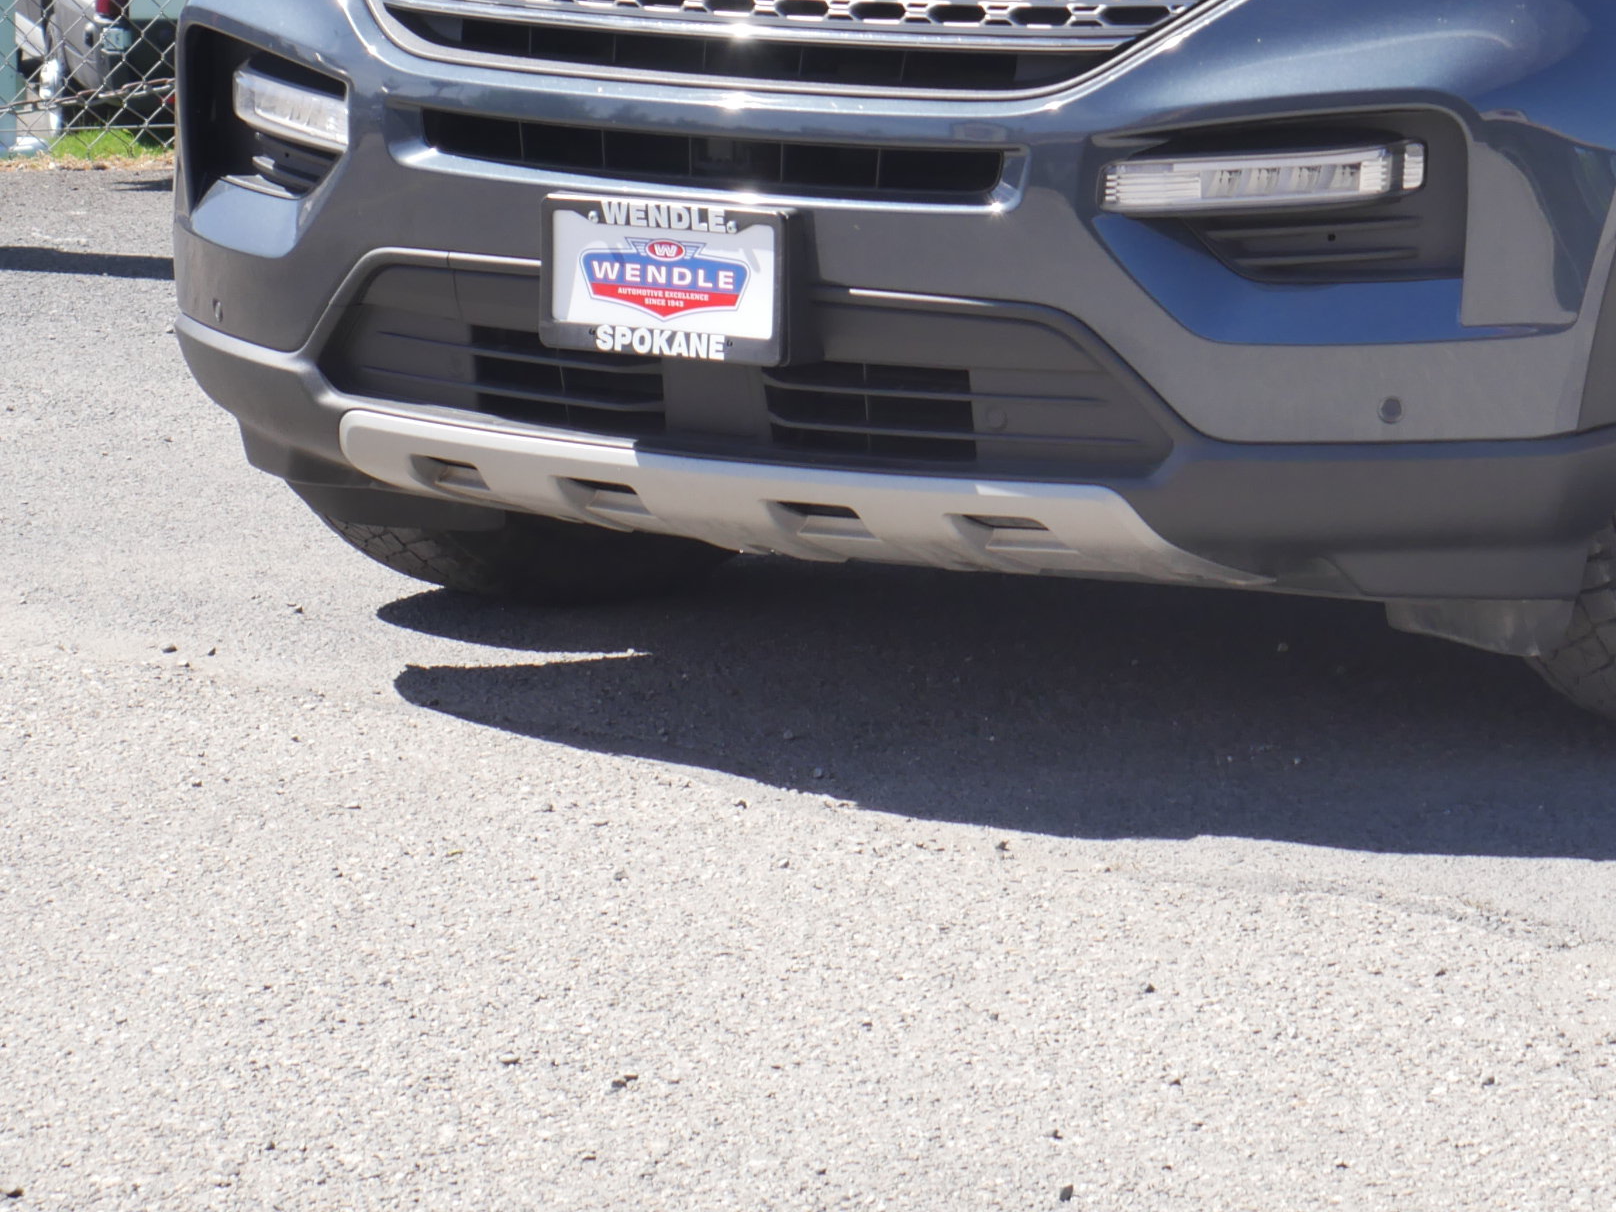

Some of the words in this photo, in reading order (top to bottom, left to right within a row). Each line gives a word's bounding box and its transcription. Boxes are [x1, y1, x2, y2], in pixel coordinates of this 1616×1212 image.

[601, 201, 726, 234] WENDLE
[592, 260, 735, 290] WENDLE
[618, 287, 664, 298] AUTOMOTIVE
[664, 291, 709, 302] EXCELLENCE
[644, 297, 666, 307] SINCE
[596, 324, 726, 361] SPOKANE
